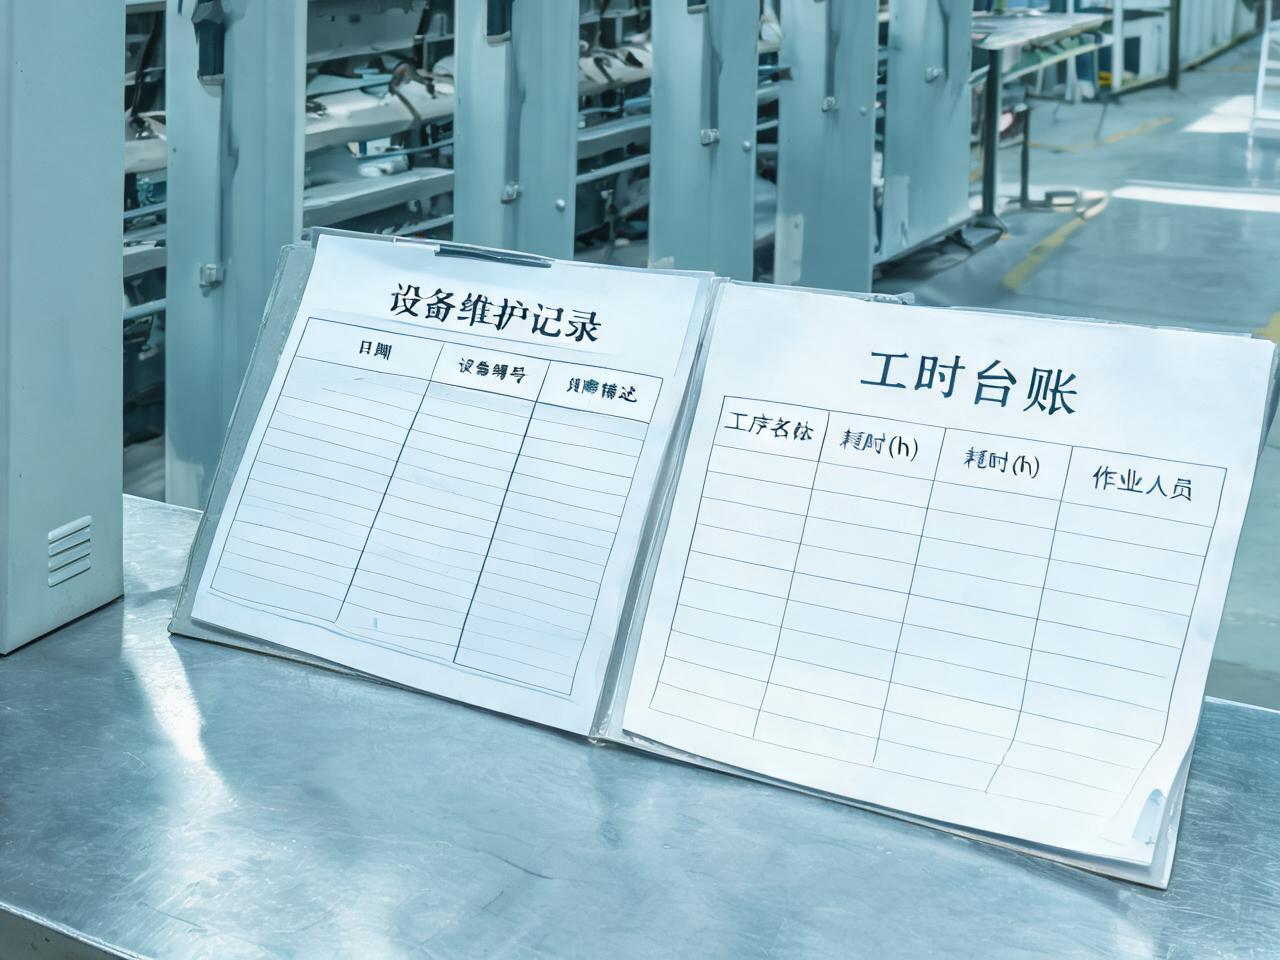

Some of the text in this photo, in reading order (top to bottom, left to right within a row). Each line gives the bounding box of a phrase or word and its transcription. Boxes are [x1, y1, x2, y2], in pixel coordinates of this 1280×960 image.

[390, 283, 602, 342] 设备维护记录
[860, 351, 1078, 416] 工时台账
[1092, 465, 1193, 501] 作业人员
